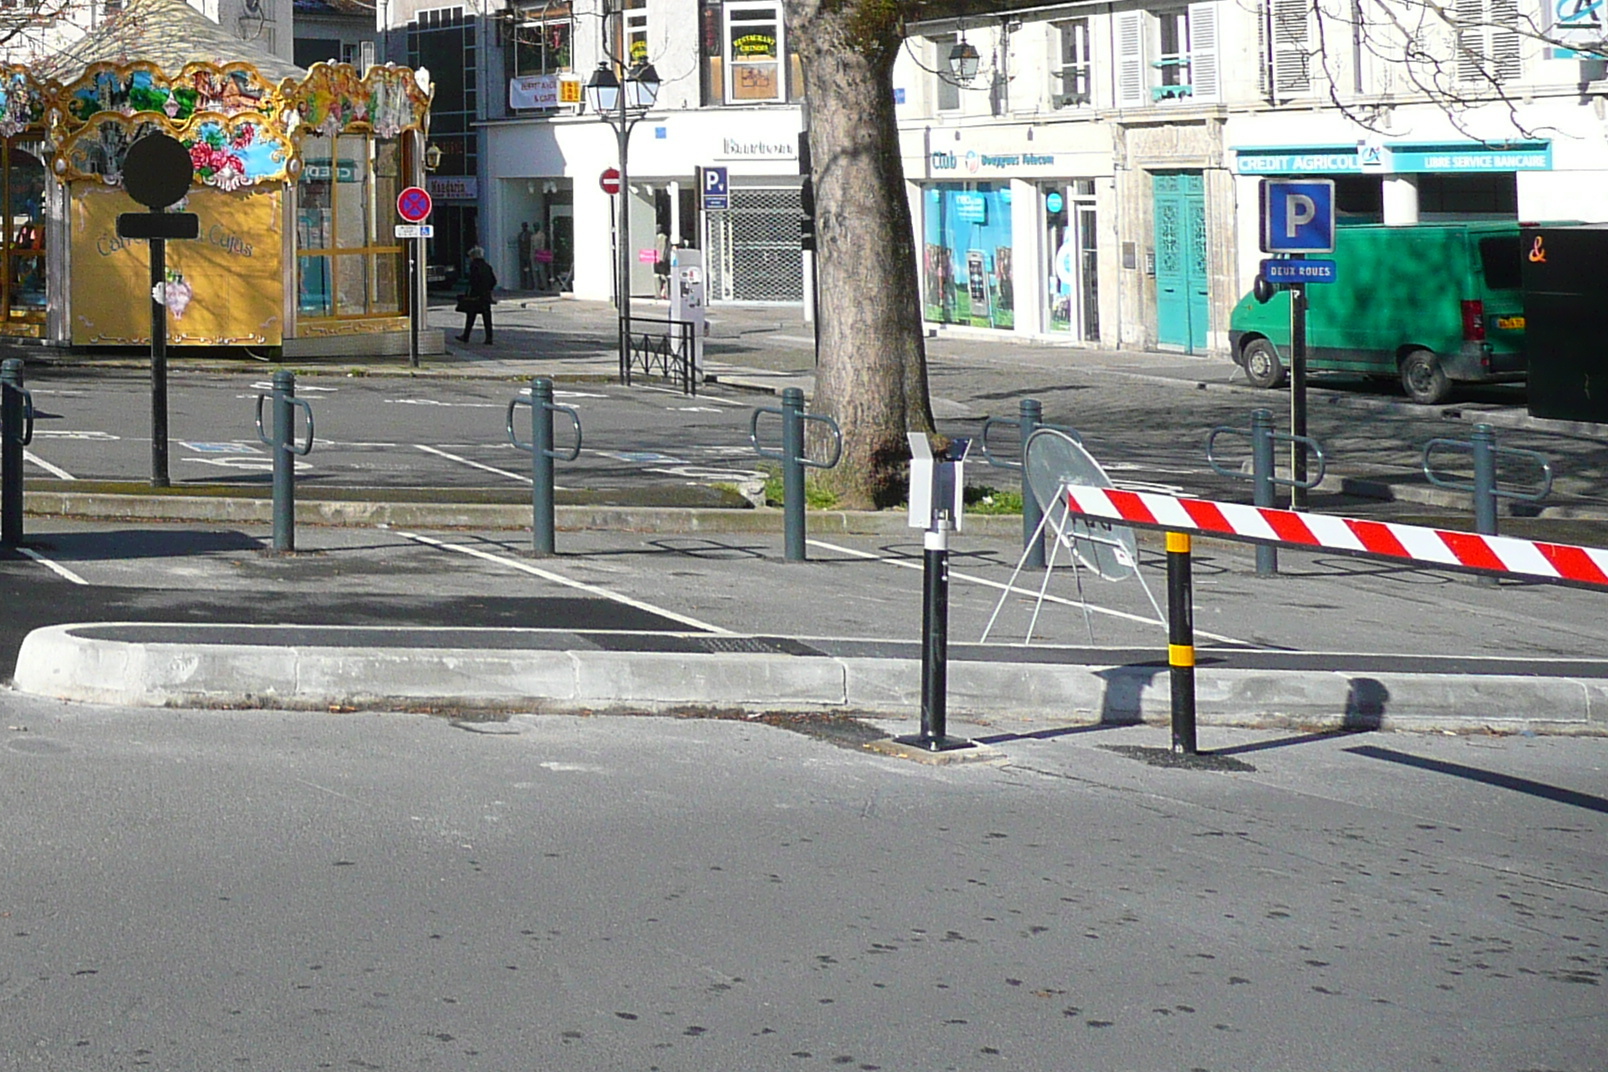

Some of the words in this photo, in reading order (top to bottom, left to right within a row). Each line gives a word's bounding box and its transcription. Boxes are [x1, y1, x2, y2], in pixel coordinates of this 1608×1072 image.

[932, 150, 957, 169] Club
[1452, 155, 1492, 168] SERVICE
[1493, 154, 1546, 167] BANCAIRE
[706, 170, 719, 191] P
[1286, 194, 1315, 238] P
[209, 224, 253, 257] Cujas
[1271, 267, 1295, 276] DEUX
[1299, 267, 1331, 276] ROUES
